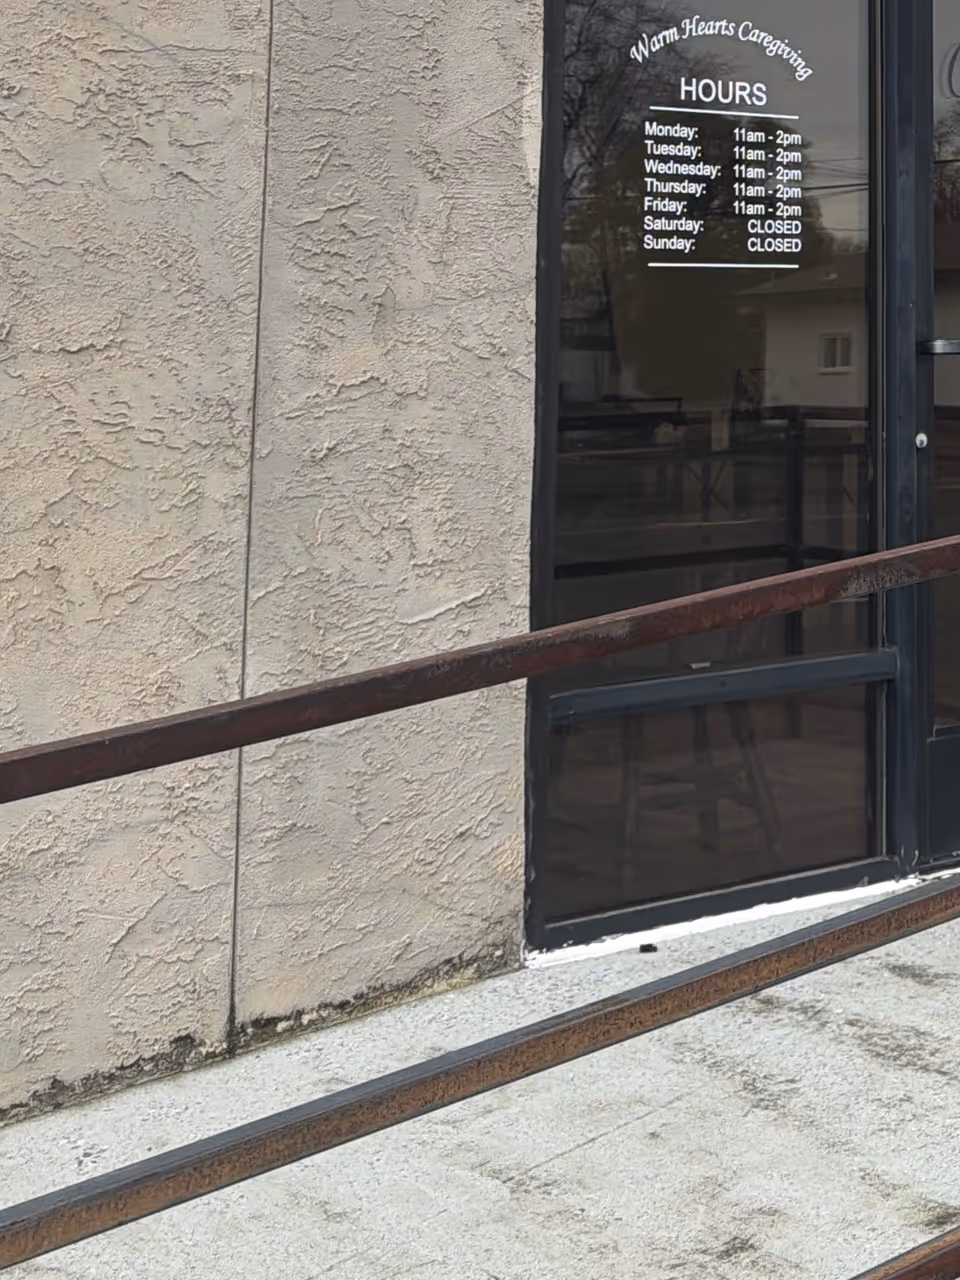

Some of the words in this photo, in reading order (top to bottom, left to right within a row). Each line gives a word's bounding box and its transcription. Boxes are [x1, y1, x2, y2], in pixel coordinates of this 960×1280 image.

[630, 26, 680, 64] Warm
[681, 15, 736, 40] Hearts
[738, 21, 814, 82] Caregiving
[680, 77, 768, 106] HOURS
[644, 121, 699, 141] Monday:
[733, 127, 766, 143] 11am
[775, 129, 802, 147] 2pm
[644, 140, 702, 160] Tuesday:
[733, 145, 766, 161] 11am
[775, 147, 802, 165] 2pm
[644, 159, 722, 179] Wednesday:
[733, 164, 766, 180] 11am
[775, 166, 802, 184] 2pm
[644, 178, 707, 197] Thursday:
[733, 182, 766, 198] 11am
[775, 184, 802, 202] 2pm
[644, 196, 688, 215] Friday:
[733, 200, 766, 216] 11am
[775, 202, 802, 220] 2pm
[643, 216, 704, 235] Saturday:
[747, 219, 802, 234] CLOSED
[643, 235, 696, 253] Sunday:
[747, 237, 802, 252] CLOSED
